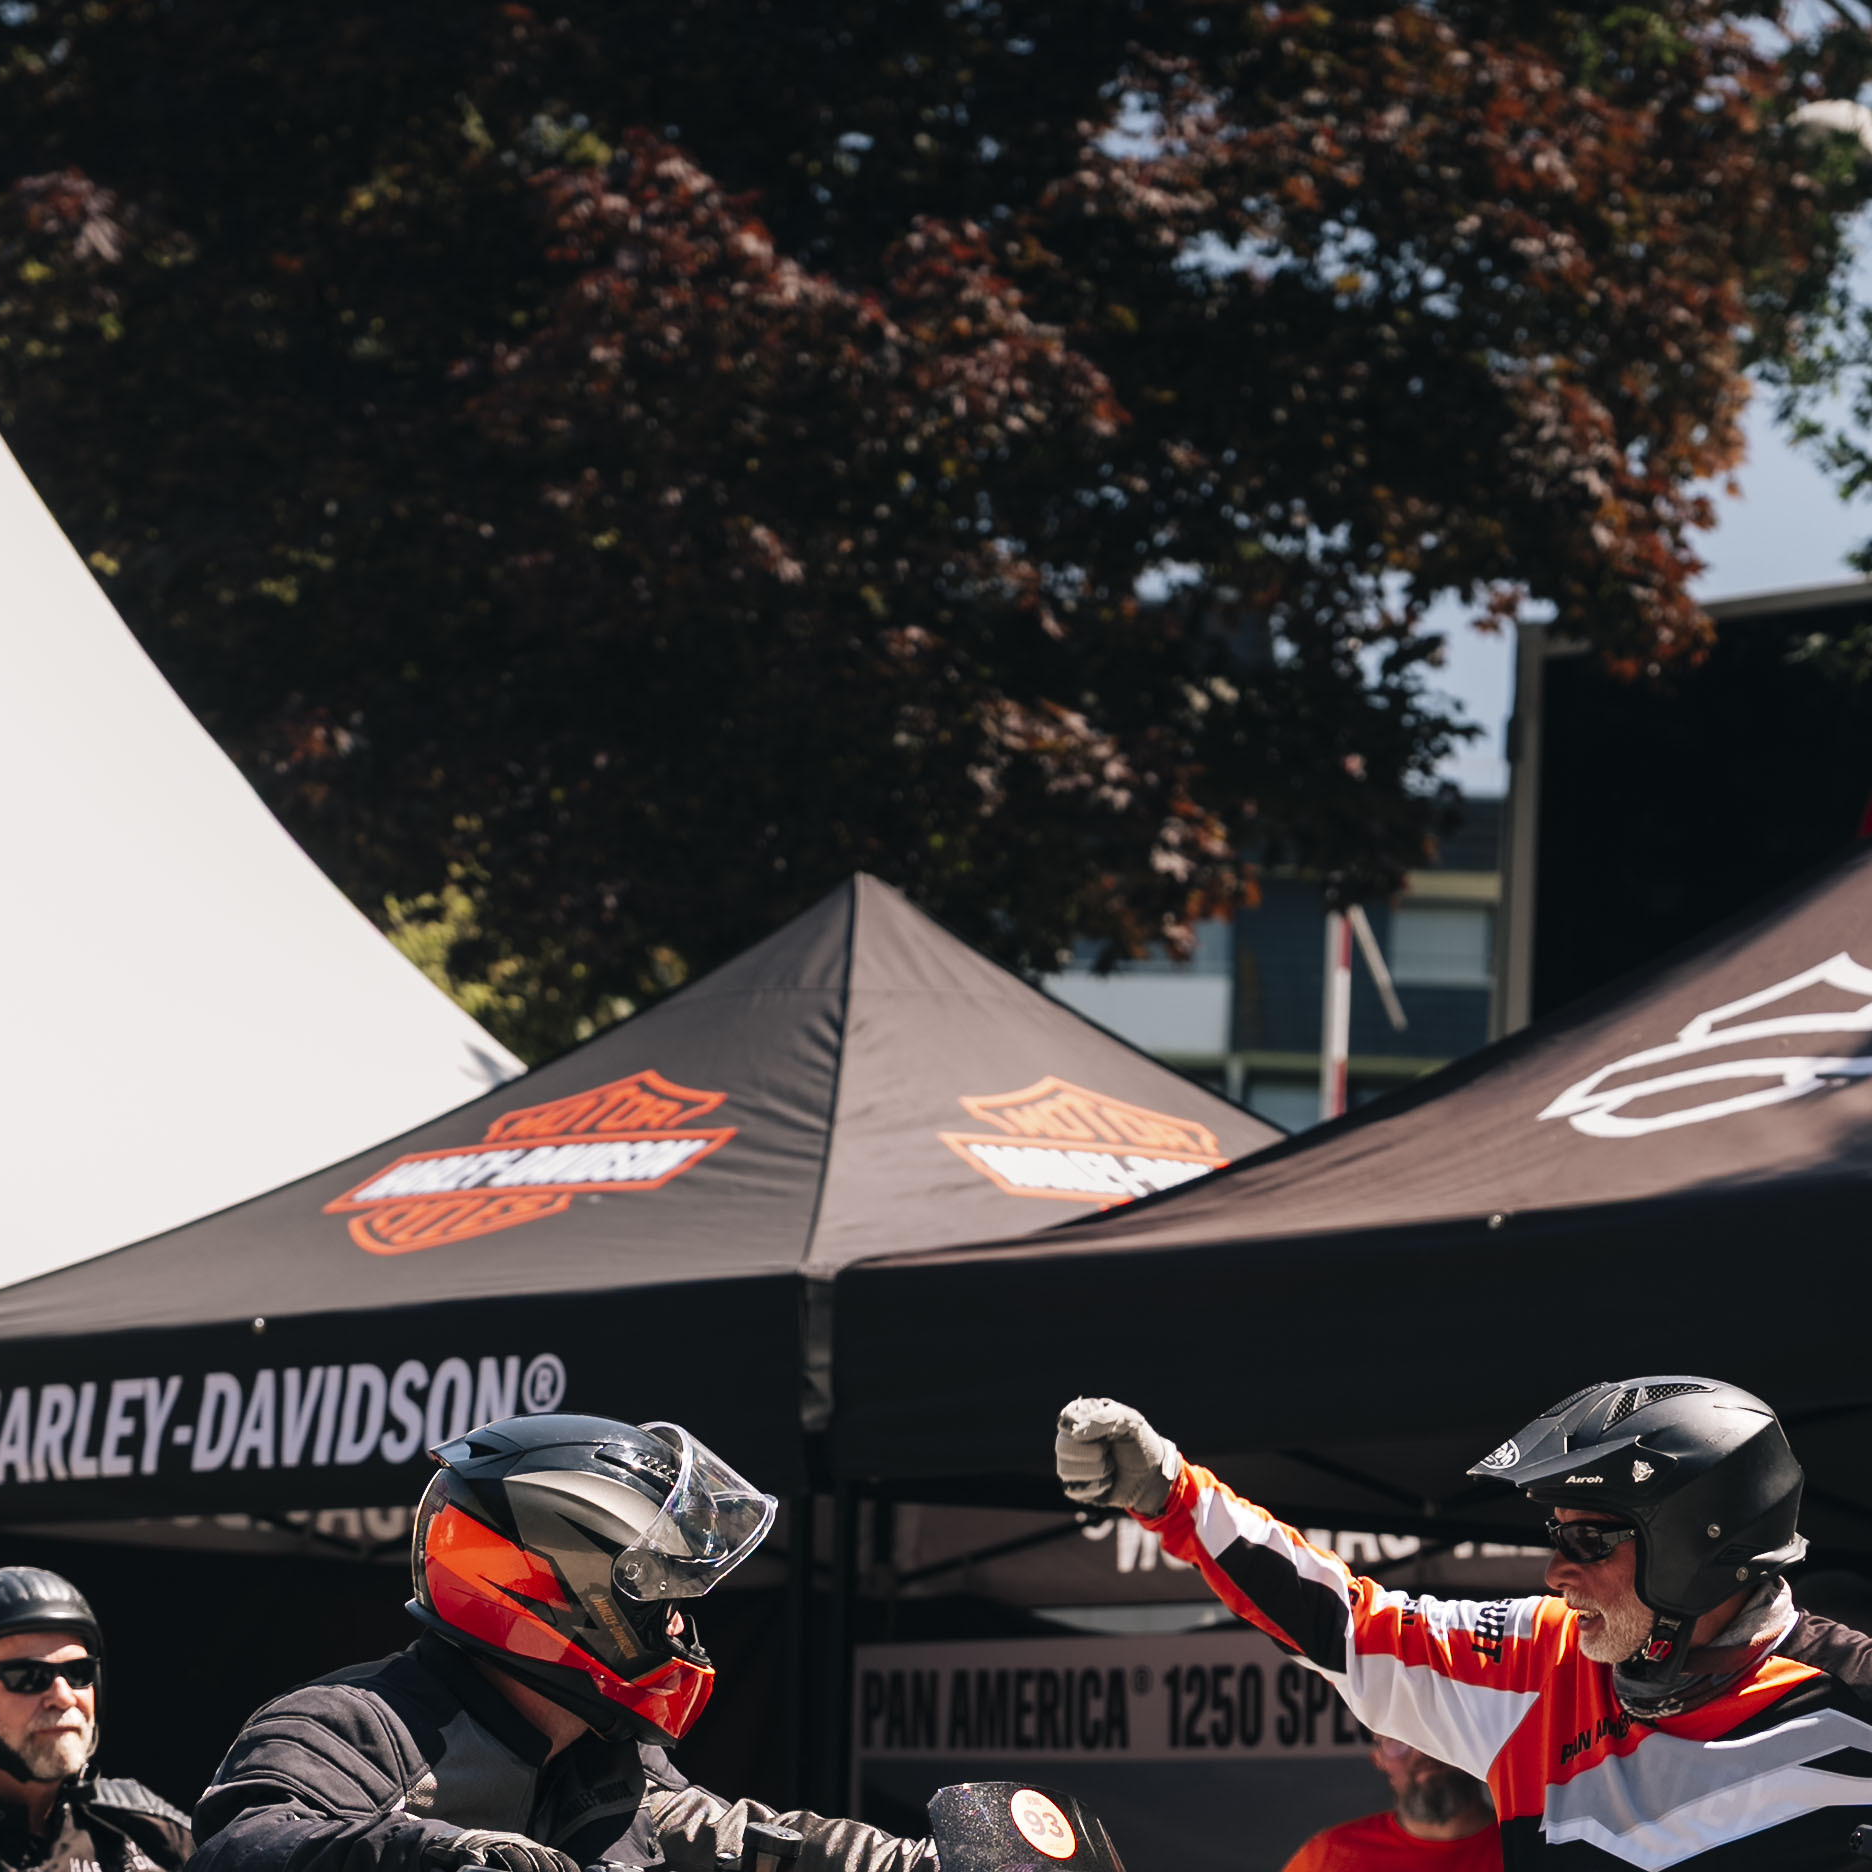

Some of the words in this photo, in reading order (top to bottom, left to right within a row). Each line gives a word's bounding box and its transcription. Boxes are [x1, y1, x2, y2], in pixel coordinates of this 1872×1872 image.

[1565, 1475, 1604, 1484] Airoh
[861, 1669, 941, 1752] PAN
[1165, 1663, 1265, 1750] 1250
[1560, 1729, 1592, 1765] PAN
[1023, 1808, 1065, 1839] 93
